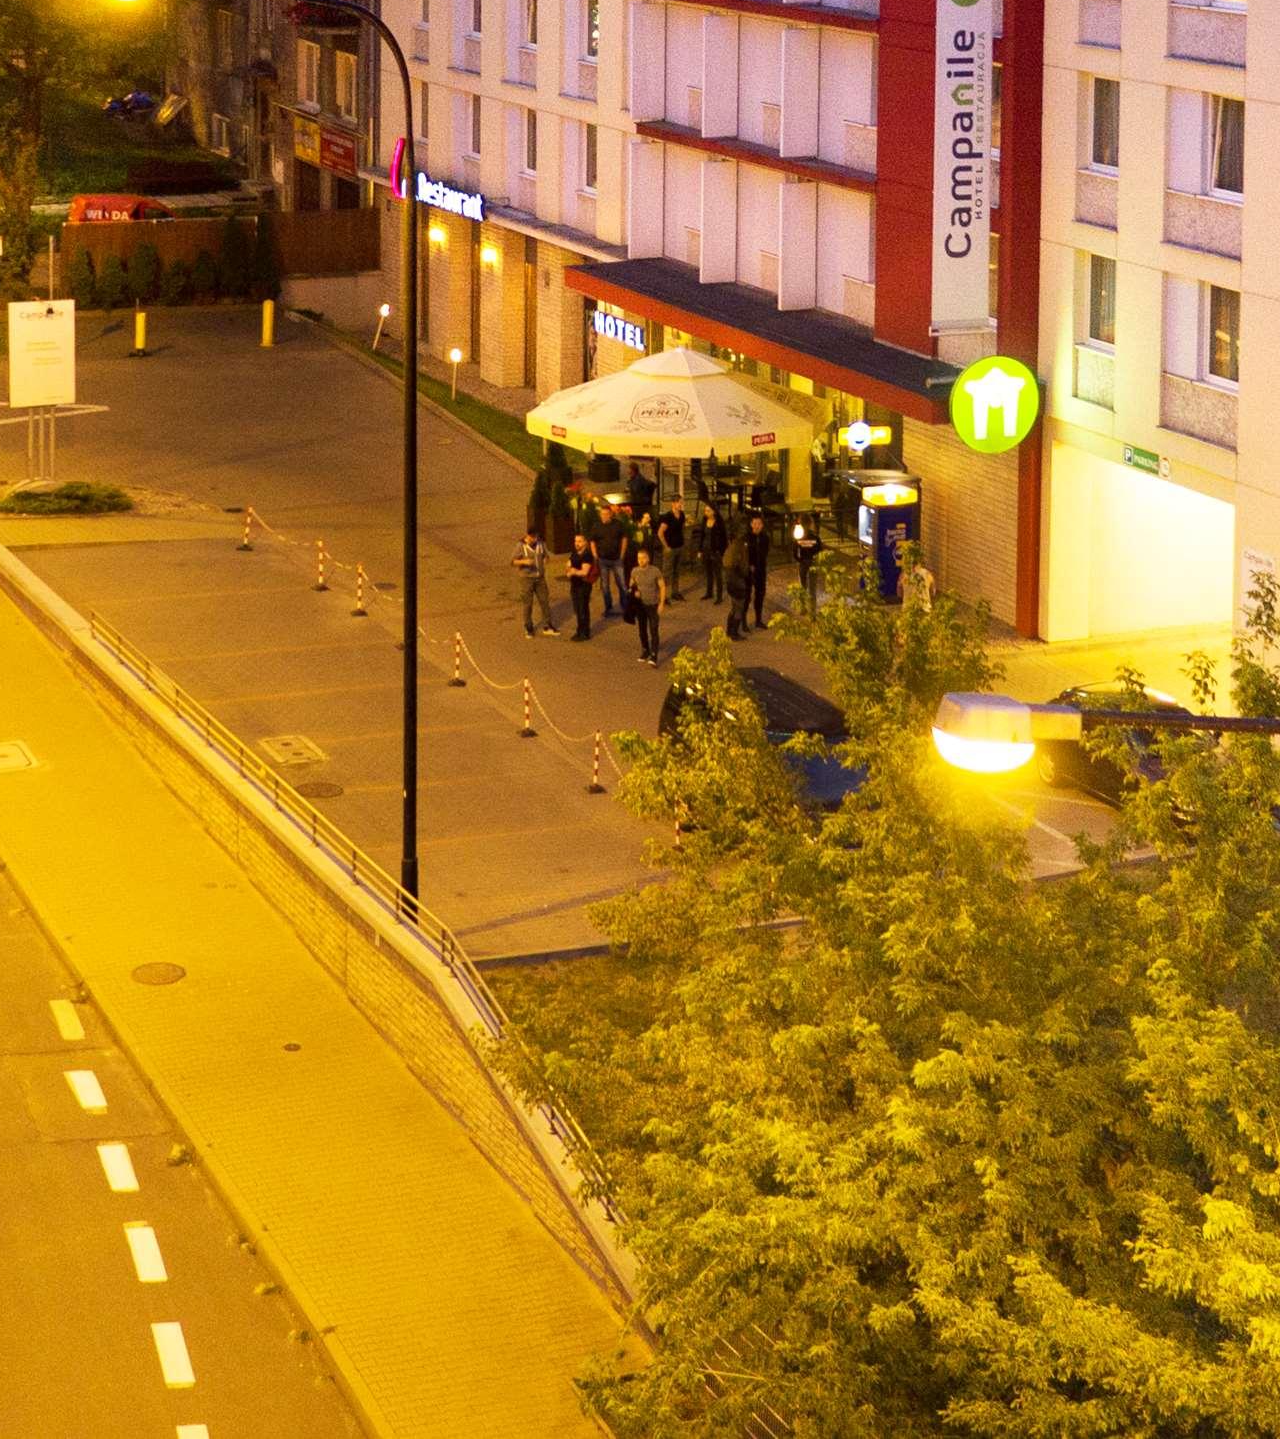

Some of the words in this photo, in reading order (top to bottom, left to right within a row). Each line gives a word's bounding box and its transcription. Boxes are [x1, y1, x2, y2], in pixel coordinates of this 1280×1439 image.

[976, 31, 986, 145] RESTAURACJA
[944, 29, 983, 259] Campanile
[974, 165, 985, 220] HOTEL
[593, 310, 646, 352] HOTEL
